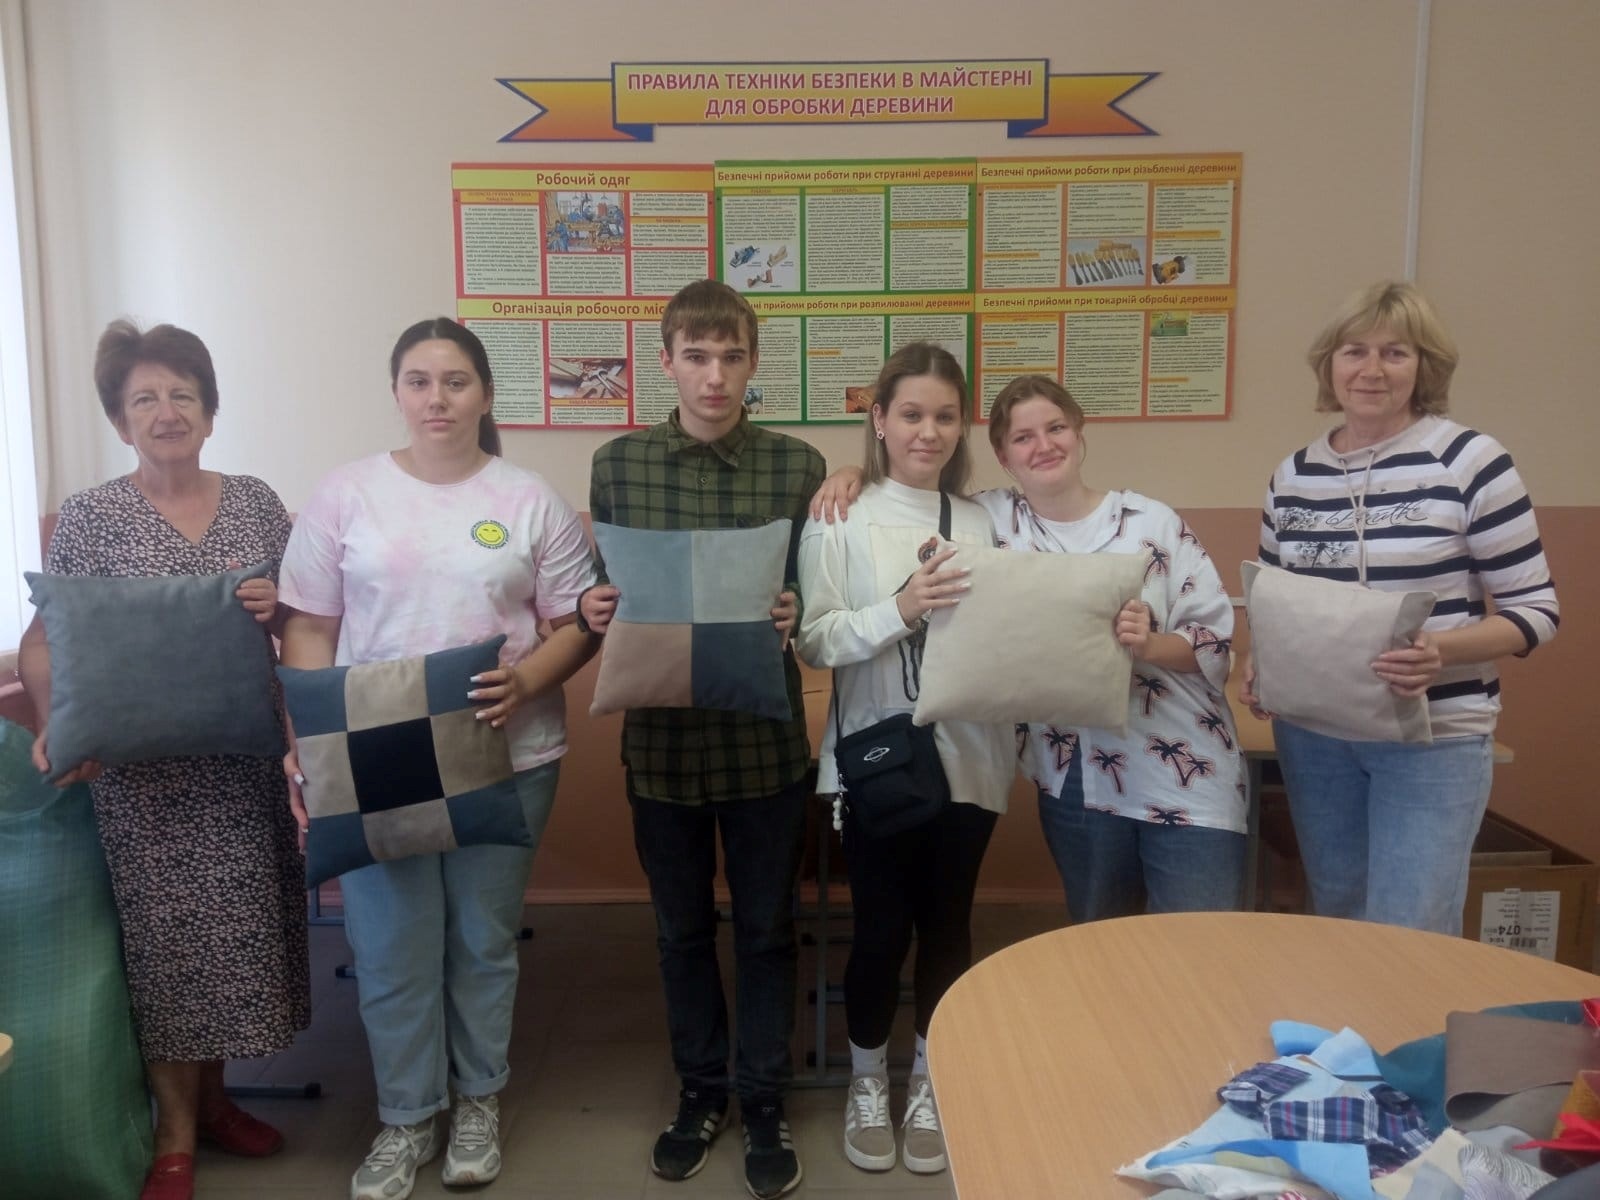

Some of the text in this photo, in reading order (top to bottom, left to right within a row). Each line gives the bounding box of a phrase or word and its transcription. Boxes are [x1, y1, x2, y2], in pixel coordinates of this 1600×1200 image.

[628, 68, 1032, 90] ПРАВИЛА ТЕХНІКИ БЕЗПЕКИ В МАЙСТЕРНІ
[705, 97, 953, 121] ДЛЯ ОБРОБКИ ДЕРЕВИНИ
[717, 169, 974, 183] Безпечні прийоми роботи при струганні деревини
[981, 165, 1236, 179] Безпечні прийоми роботи при різьбленні деревини
[536, 173, 630, 187] Робочий одяг
[763, 300, 805, 311] прийоми
[806, 299, 839, 311] роботи
[840, 301, 858, 310] при
[859, 299, 924, 310] розпилюванні
[925, 300, 970, 309] деревини
[983, 294, 1228, 308] Безпечні прийоми при токарній обробці деревини
[492, 301, 664, 316] Організація робочого міс
[1498, 925, 1521, 936] 074
